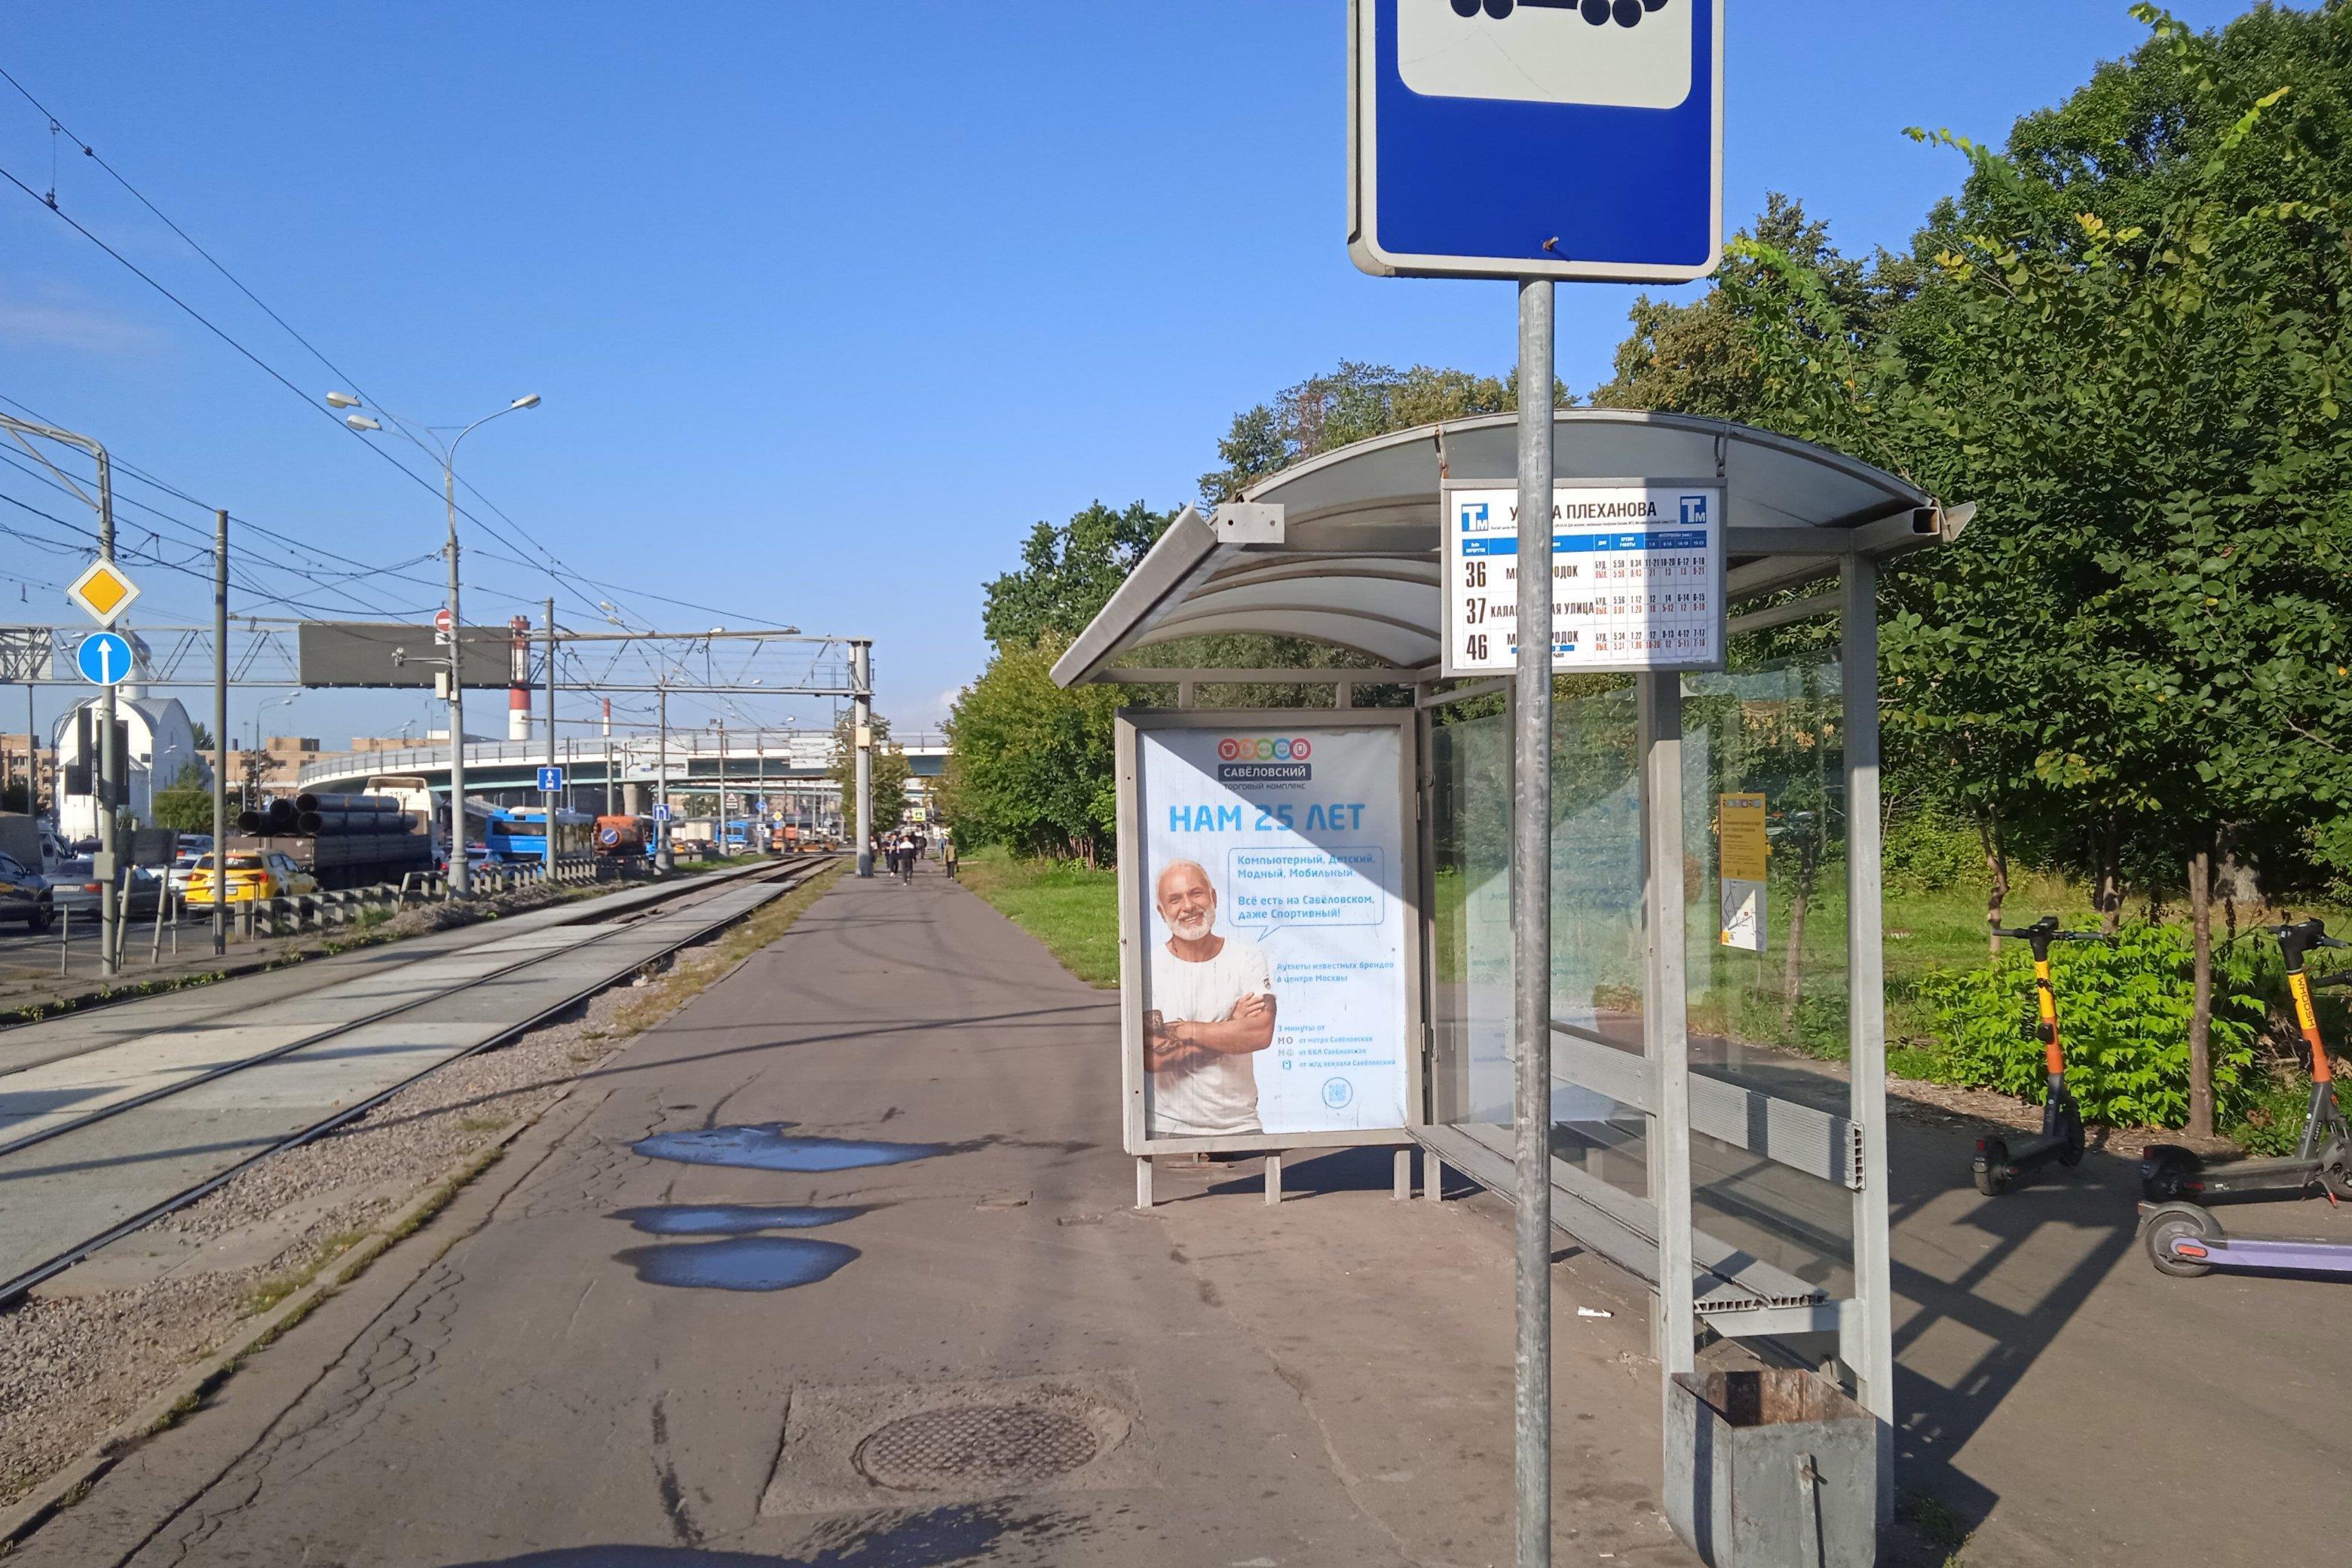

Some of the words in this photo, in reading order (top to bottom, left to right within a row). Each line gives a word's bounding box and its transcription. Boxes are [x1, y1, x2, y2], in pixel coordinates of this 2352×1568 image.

[1566, 502, 1657, 519] ПЛЕХАНОВА
[1465, 561, 1487, 587] 36
[1466, 598, 1487, 624] 37
[1563, 602, 1594, 616] УЛИЦА
[1466, 634, 1487, 660] 46
[1223, 765, 1306, 778] САВЁЛОВСКИЙ
[1224, 782, 1264, 791] торговый
[1170, 805, 1242, 832] НАМ
[1255, 804, 1294, 831] 25
[1306, 804, 1366, 831] ЛЕТ
[1238, 855, 1325, 866] Компьютерный,
[1238, 868, 1286, 880] Модный,
[1238, 896, 1257, 905] Всё
[1303, 894, 1375, 905] Савёловском,
[1238, 911, 1267, 920] даже
[1270, 908, 1340, 919] Спортивный!
[1276, 963, 1311, 972] Аутлеты
[1312, 962, 1357, 970] известных
[1359, 961, 1394, 970] брендов
[2297, 977, 2316, 1027] WHOOSH
